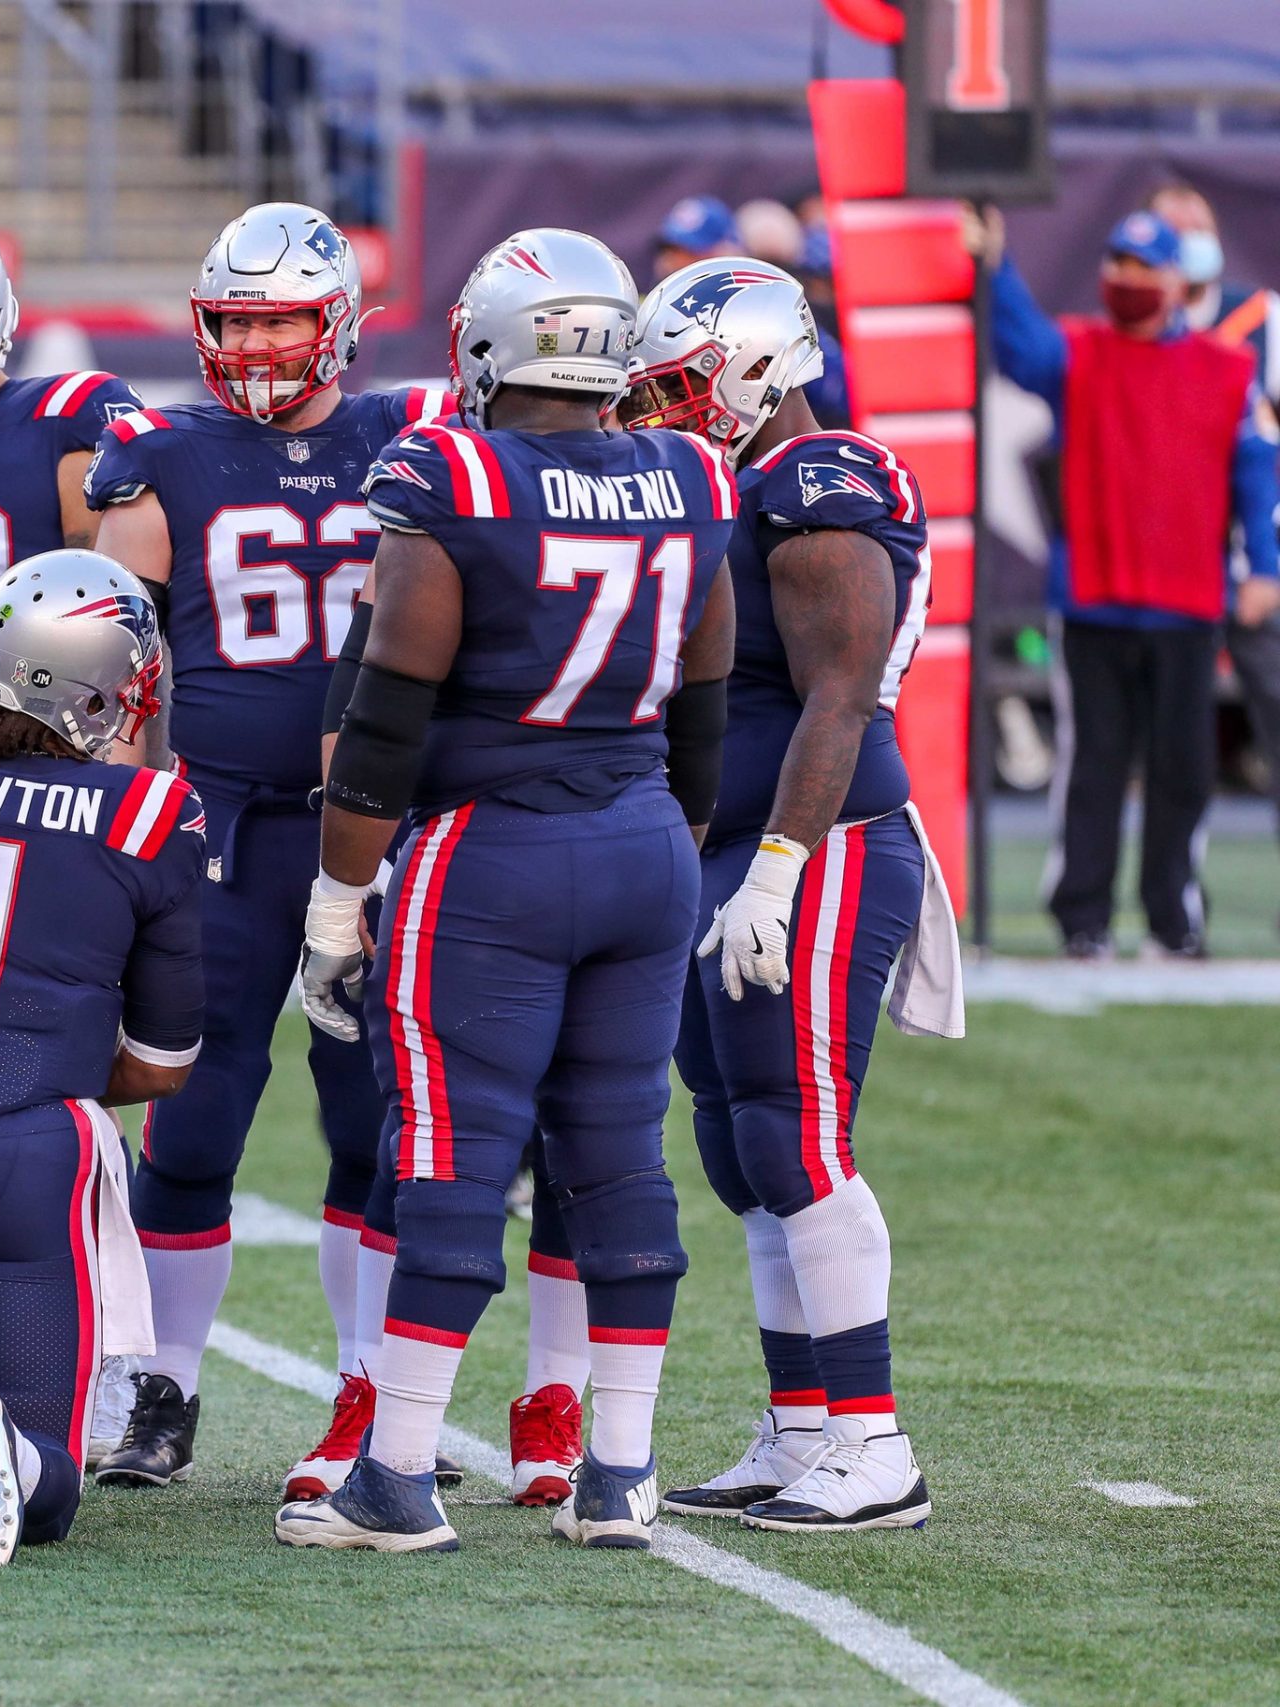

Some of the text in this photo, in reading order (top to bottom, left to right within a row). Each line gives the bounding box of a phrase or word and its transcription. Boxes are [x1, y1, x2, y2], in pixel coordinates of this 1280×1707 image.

[229, 290, 267, 301] PATRIOTS
[551, 372, 575, 382] BLACK
[577, 375, 597, 384] LIVES
[279, 476, 336, 490] PATRIOTS
[539, 469, 686, 520] ONWENU
[203, 503, 381, 666] 62
[520, 531, 694, 727] 71
[33, 672, 51, 686] JM
